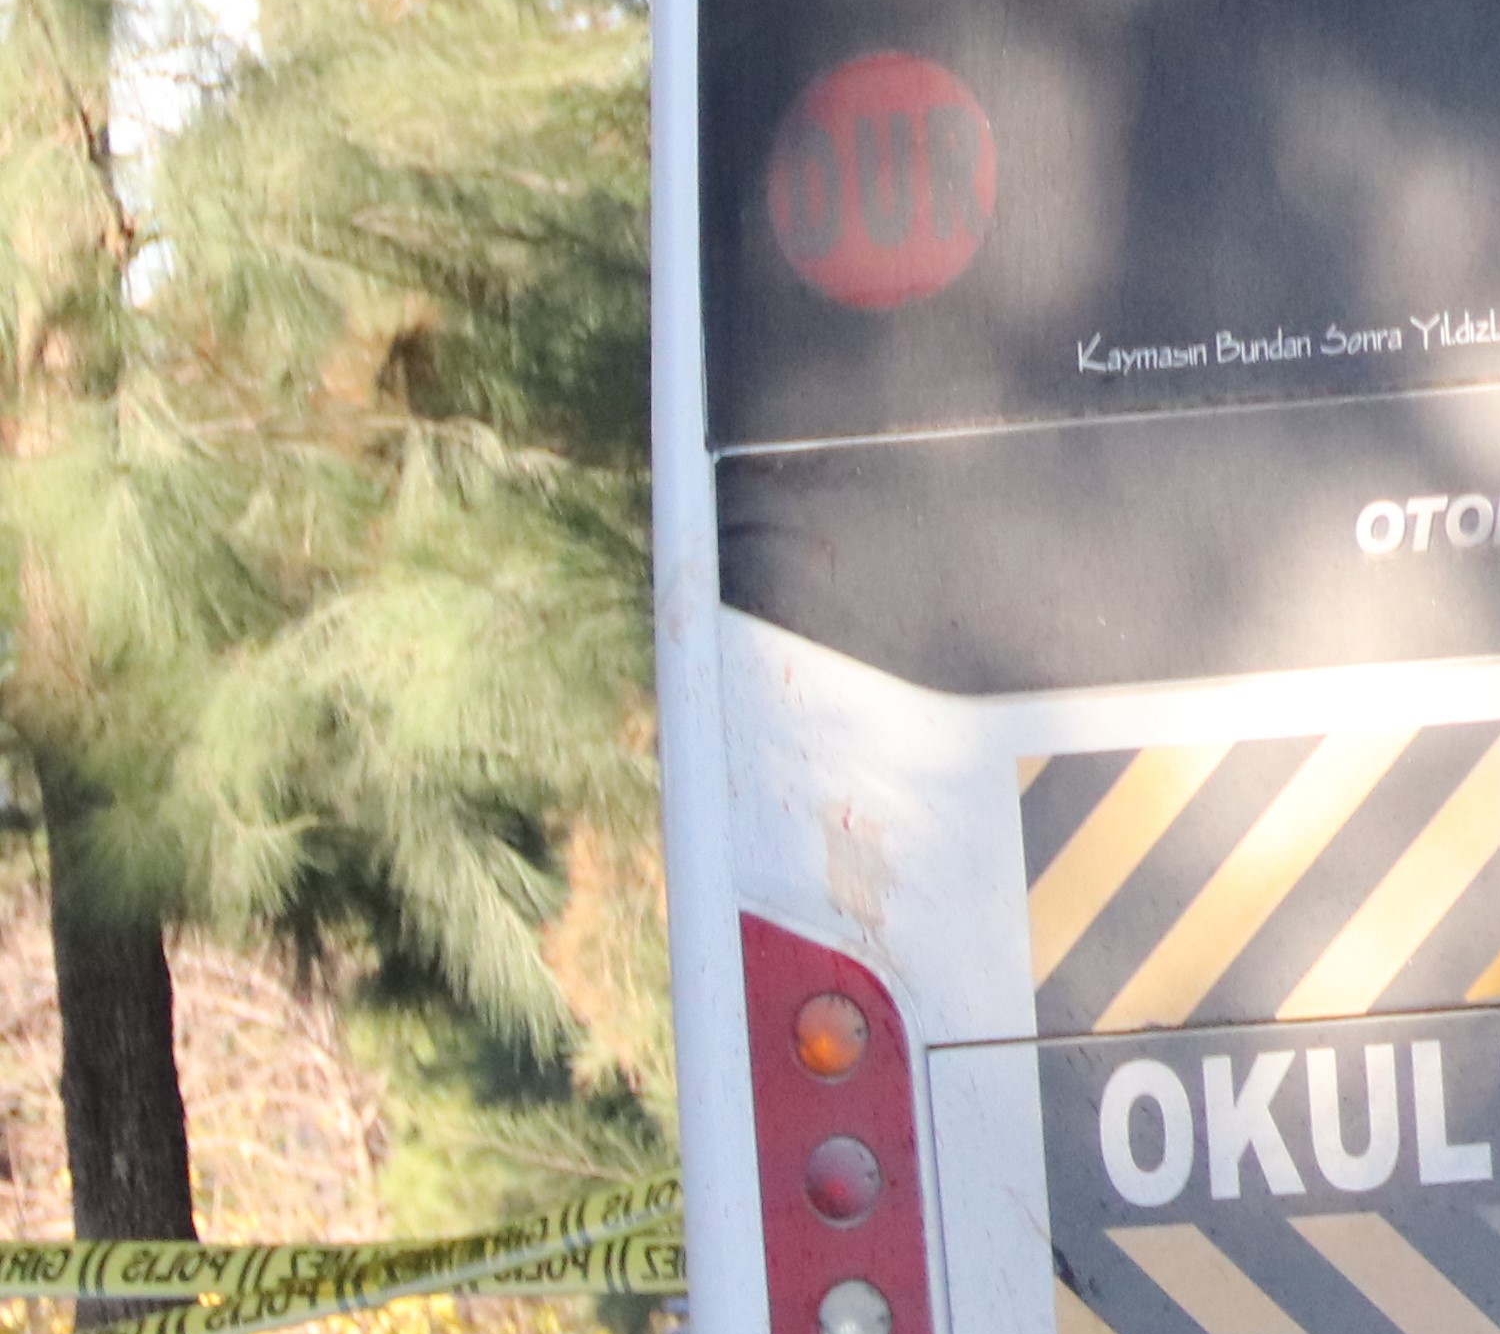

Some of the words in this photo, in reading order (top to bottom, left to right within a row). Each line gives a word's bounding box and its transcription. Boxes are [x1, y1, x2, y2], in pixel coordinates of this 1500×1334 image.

[772, 104, 985, 261] DUR
[1077, 332, 1207, 375] Kaymasın
[1215, 326, 1311, 364] Bundan
[1320, 323, 1402, 355] Sonra
[1098, 1039, 1494, 1208] OKUL
